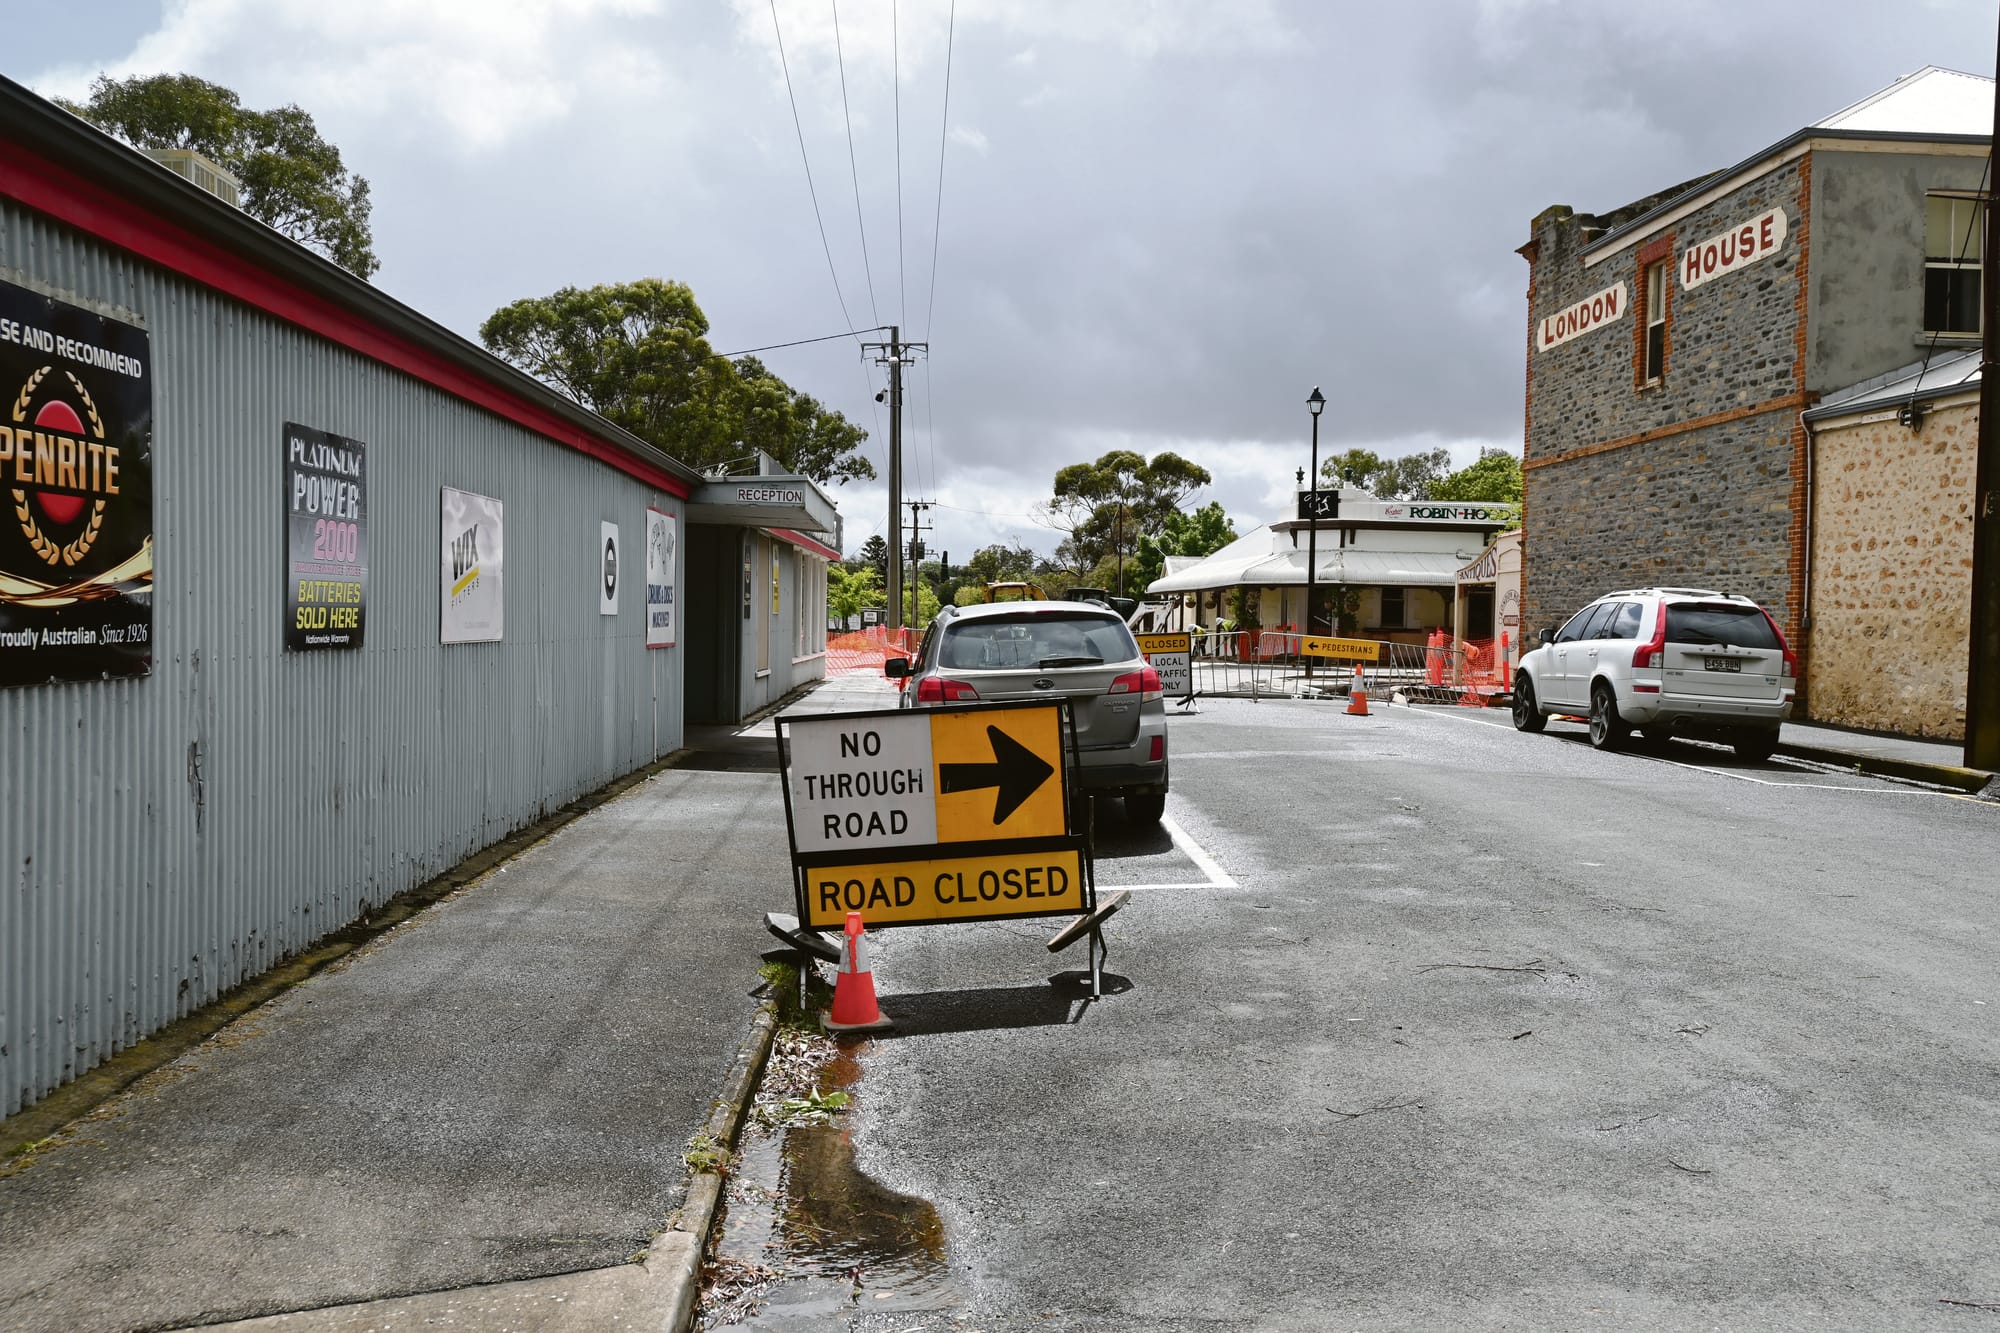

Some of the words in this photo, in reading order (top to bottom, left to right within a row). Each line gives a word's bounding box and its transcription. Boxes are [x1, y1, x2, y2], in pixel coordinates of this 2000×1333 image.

[1686, 215, 1774, 283] HOUSE
[1544, 289, 1617, 345] LONDON
[0, 318, 20, 344] SE
[23, 325, 54, 353] AND
[56, 335, 142, 378] RECOMMEND
[0, 425, 120, 495] PENRITE
[290, 436, 361, 477] PLATINUM
[293, 470, 360, 519] POWER
[738, 489, 802, 502] RECEPTION
[1409, 506, 1459, 519] ROBIN
[314, 518, 358, 562] 2000
[451, 523, 478, 581] WIX
[1459, 546, 1497, 581] ANTIQUES
[297, 579, 361, 603] BATTERIES
[296, 606, 327, 630] SOLD
[329, 607, 359, 629] HERE
[0, 627, 38, 650] roudly
[41, 627, 96, 646] Australian
[99, 623, 125, 645] Since
[126, 623, 148, 642] 1926
[1144, 640, 1186, 649] CLOSED
[1322, 643, 1374, 655] PEDESTRIANS
[1155, 657, 1183, 666] LOCAL
[1155, 669, 1187, 678] RAFFIC
[840, 731, 881, 758] NO
[804, 768, 923, 800] THROUGH
[823, 809, 908, 839] ROAD
[819, 875, 916, 912] ROAD
[934, 865, 1069, 904] CLOSED
